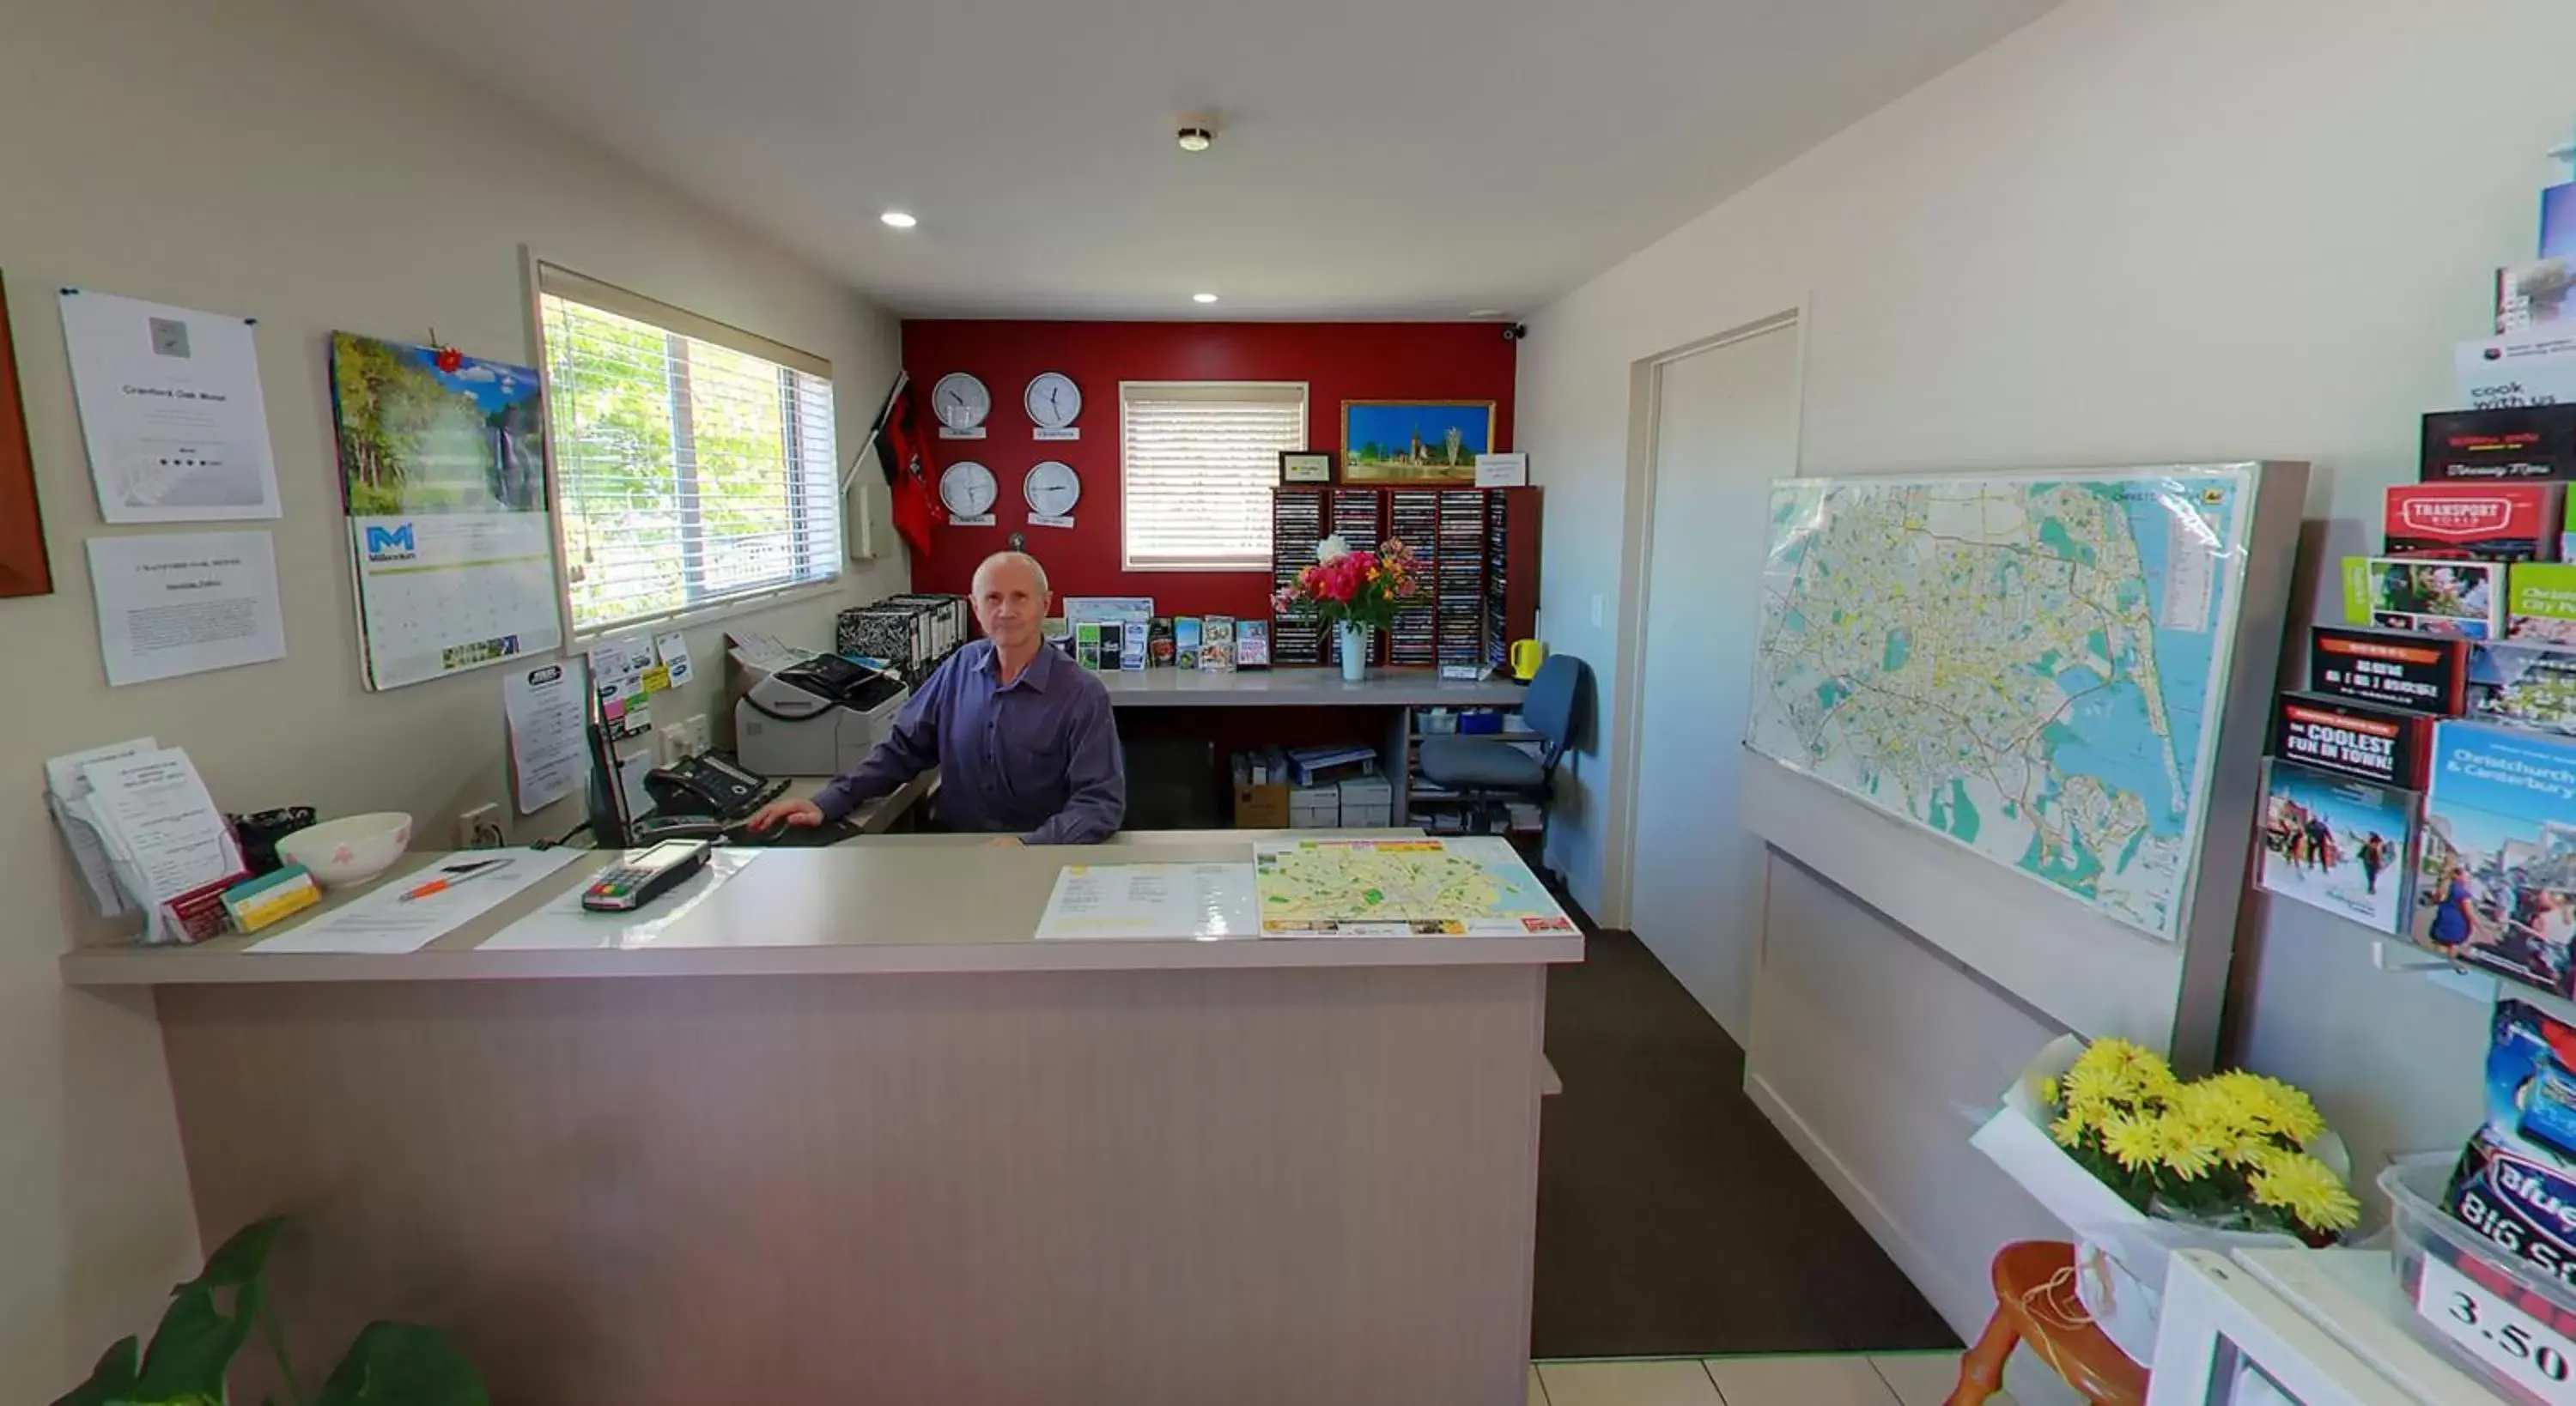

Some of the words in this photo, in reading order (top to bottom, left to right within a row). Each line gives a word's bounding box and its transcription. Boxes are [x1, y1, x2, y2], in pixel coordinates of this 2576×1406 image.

[2470, 381, 2524, 397] cook
[2414, 503, 2500, 517] TRANSPORT
[2287, 735, 2318, 755] FUN
[2320, 742, 2338, 759] IN
[2341, 747, 2395, 772] TOWN!
[2306, 724, 2396, 755] COOLEST
[2452, 748, 2576, 785] Christchurch
[2464, 763, 2574, 800] Canterbury
[2460, 1191, 2525, 1253] BIG
[2448, 1290, 2570, 1383] 3.50
